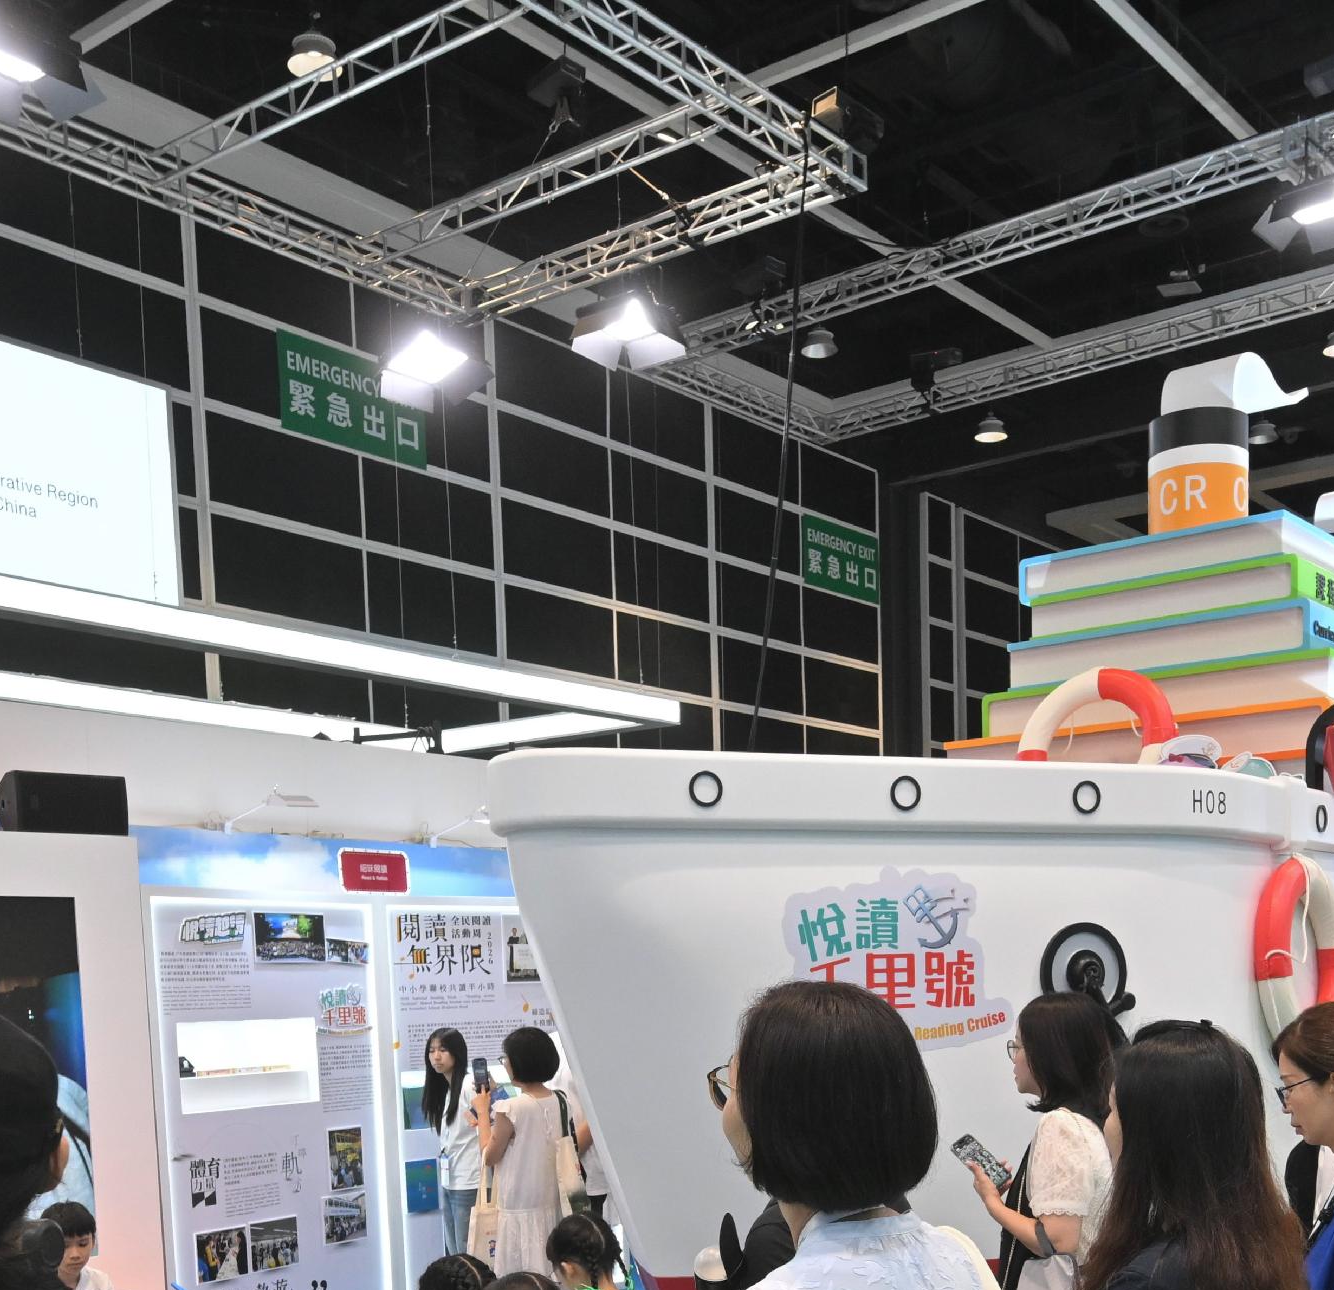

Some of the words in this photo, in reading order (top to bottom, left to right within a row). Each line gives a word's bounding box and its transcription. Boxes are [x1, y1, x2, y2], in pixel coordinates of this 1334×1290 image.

[286, 350, 381, 398] EMERGENCY
[289, 379, 419, 450] 緊急出口
[47, 483, 99, 509] Region
[1159, 474, 1207, 515] CR
[807, 528, 856, 556] EMERGENCY
[858, 545, 875, 562] EXIT
[808, 548, 876, 591] 緊急出口
[1193, 789, 1226, 815] H08
[797, 897, 899, 962] 悅讀
[914, 1019, 965, 1042] Reading
[966, 1009, 1007, 1034] Cruise
